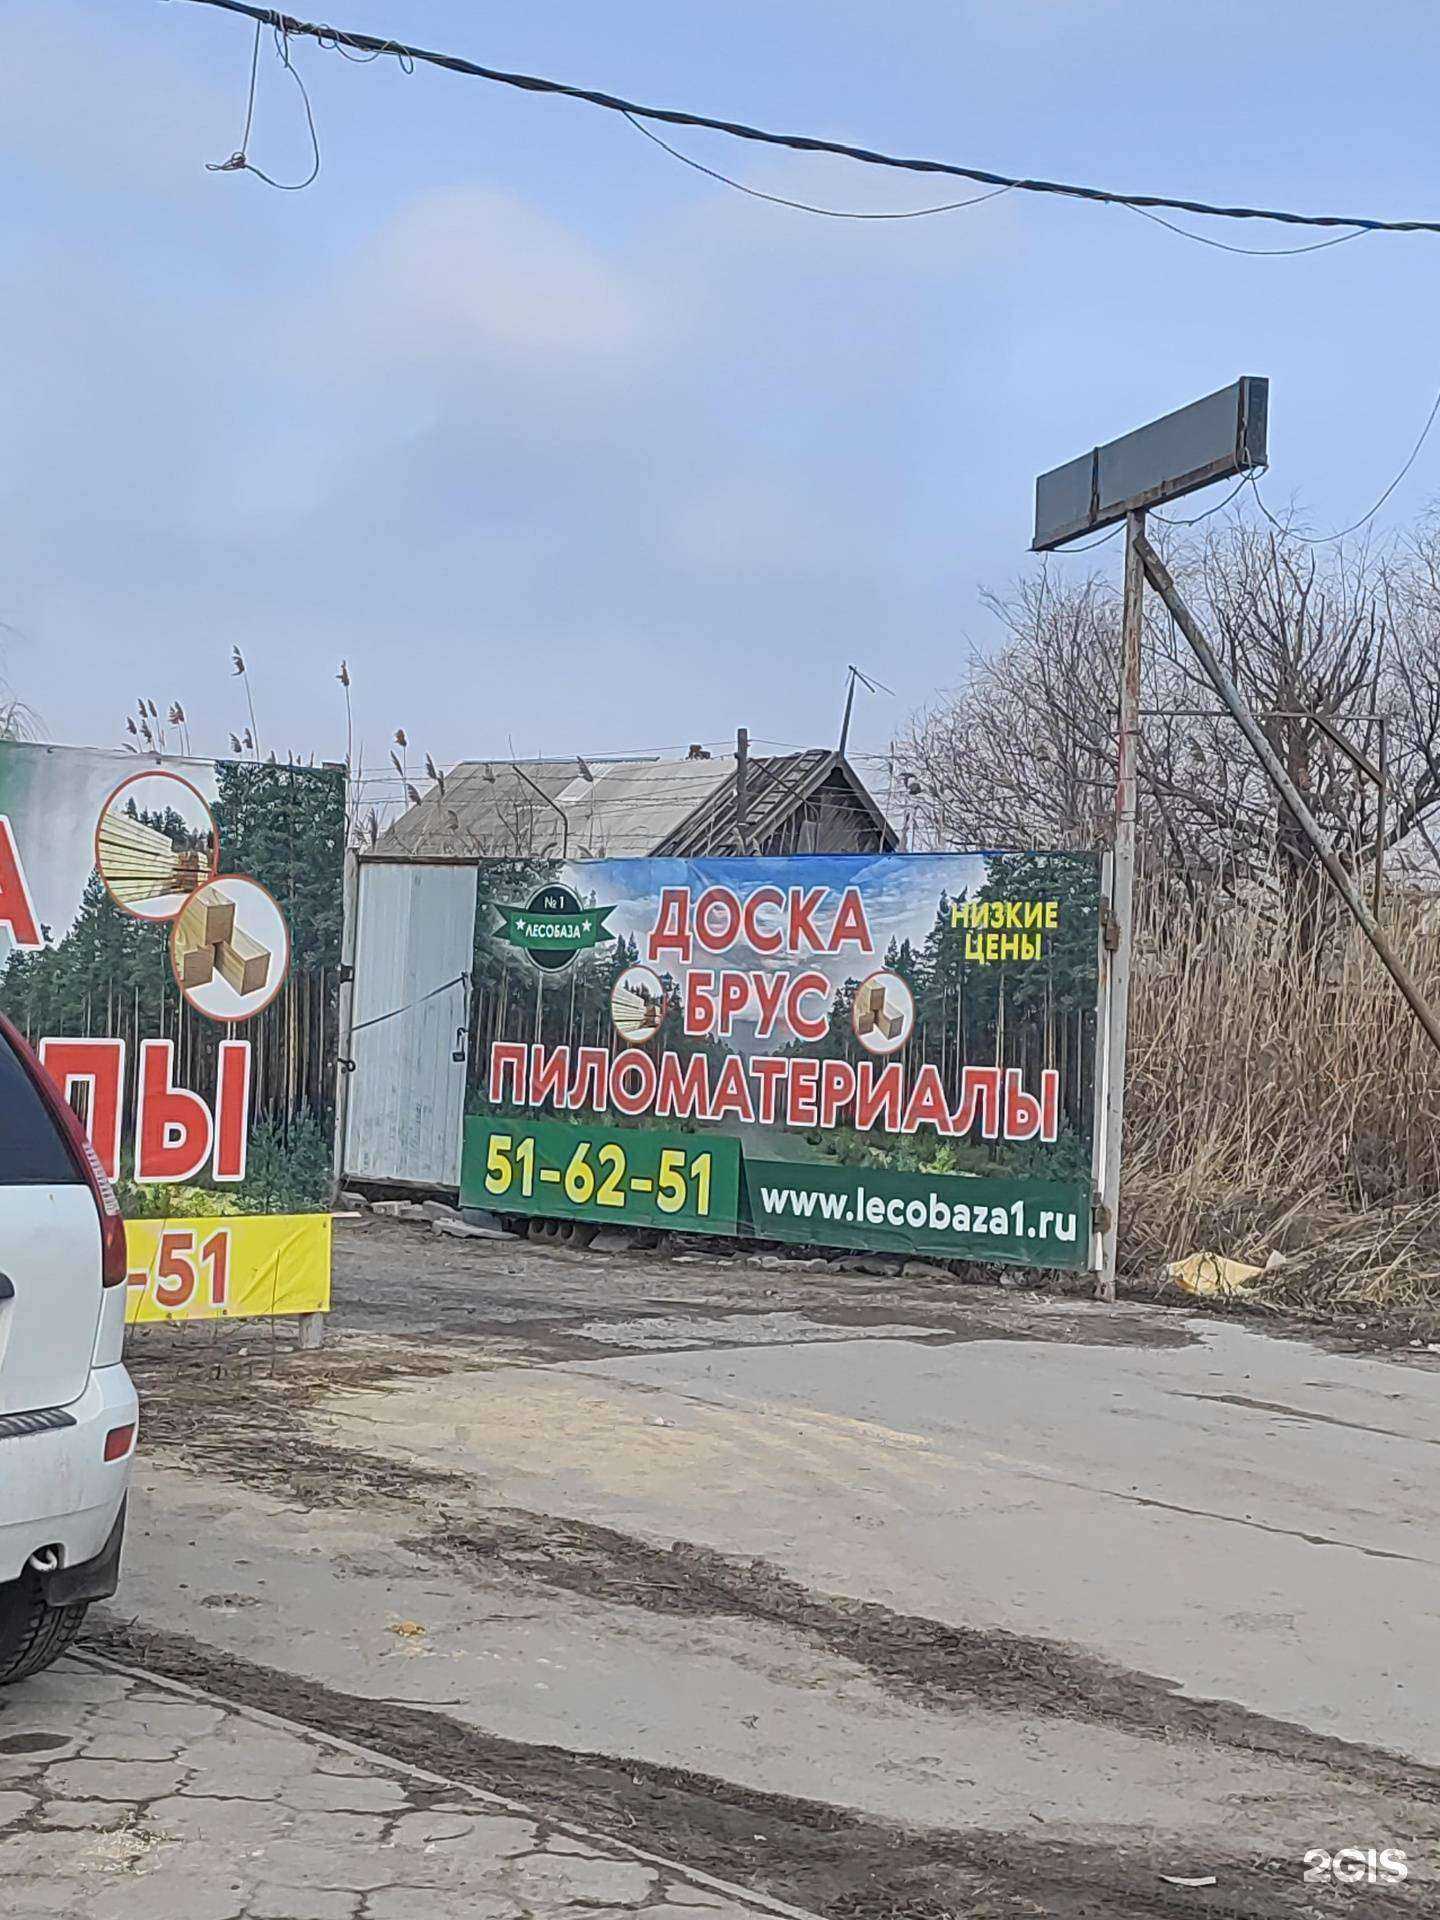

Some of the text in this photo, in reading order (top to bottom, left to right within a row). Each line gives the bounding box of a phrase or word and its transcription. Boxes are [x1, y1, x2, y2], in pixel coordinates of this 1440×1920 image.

[525, 924, 581, 938] ЛЕСОБАЗА
[648, 885, 875, 962] ДОСКА
[951, 901, 1058, 928] НИЗКИЕ
[965, 933, 1042, 964] ЦЕНЫ
[683, 968, 831, 1042] БРУС
[489, 1041, 1060, 1143] ПИЛОМАТЕРИАЛЫ
[484, 1134, 712, 1216] 51-62-51
[761, 1187, 1078, 1243] www.lecobaza1.ru
